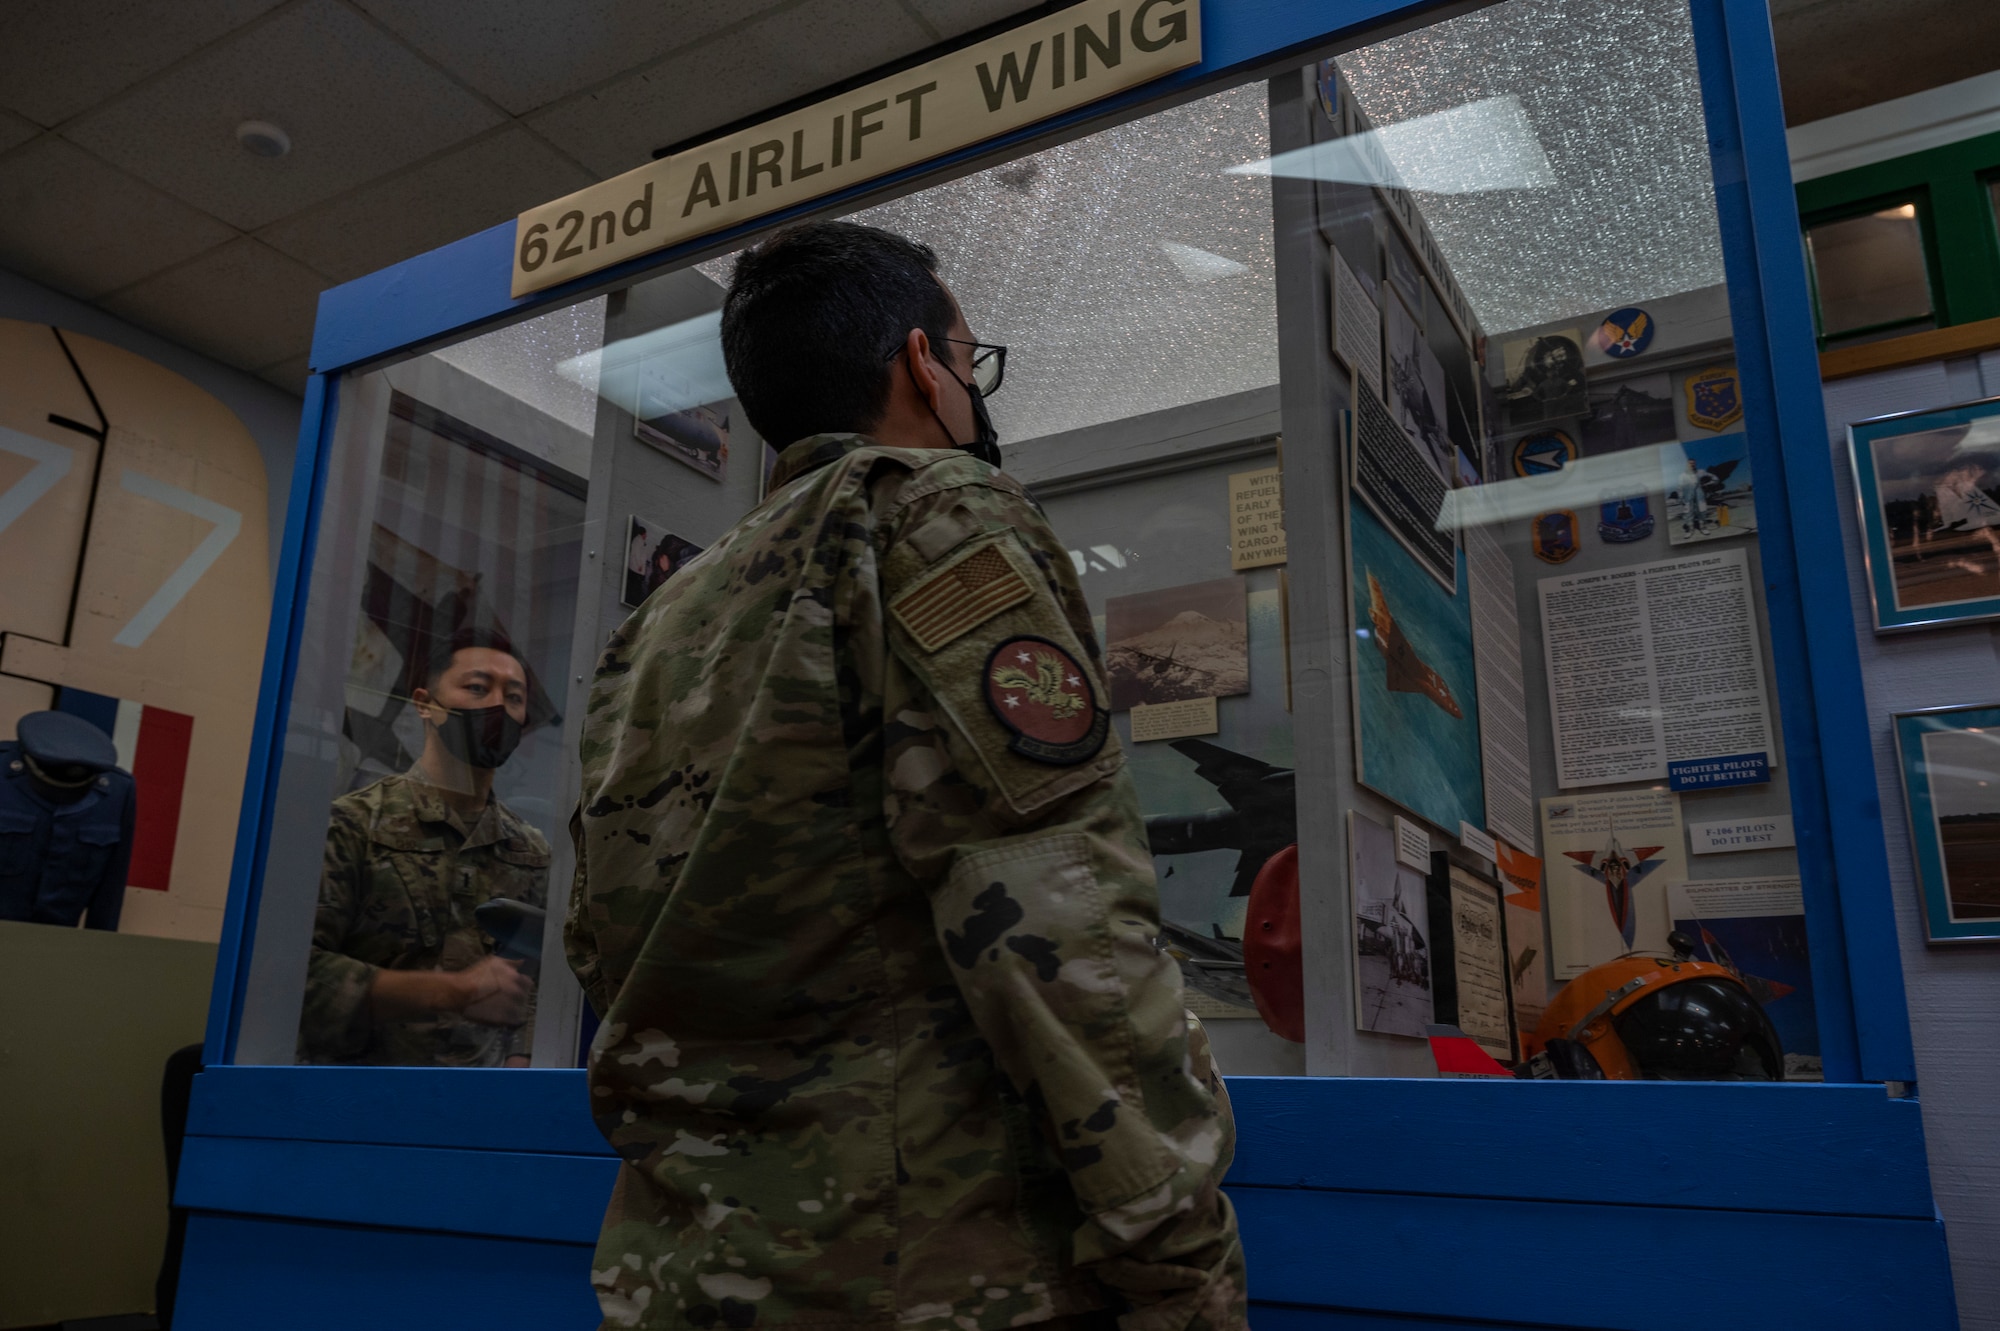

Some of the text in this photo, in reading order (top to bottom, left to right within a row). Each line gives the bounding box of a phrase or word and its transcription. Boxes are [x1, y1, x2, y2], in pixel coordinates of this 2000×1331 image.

[520, 0, 1188, 273] 62nd AIRLIFT WING
[1249, 474, 1279, 486] WITH
[1236, 499, 1271, 512] EARLY
[1237, 510, 1280, 525] OF THE
[1237, 524, 1268, 536] WING
[1238, 535, 1279, 549] CARGO
[1611, 571, 1637, 580] ROGERS
[1648, 564, 1676, 574] FIGHTER
[1672, 759, 1764, 776] FIGHTER PILOTS
[1680, 770, 1757, 784] DO IT BETTER
[1706, 823, 1777, 837] F-106 PILOTS
[1711, 833, 1773, 846] DO IT BEST
